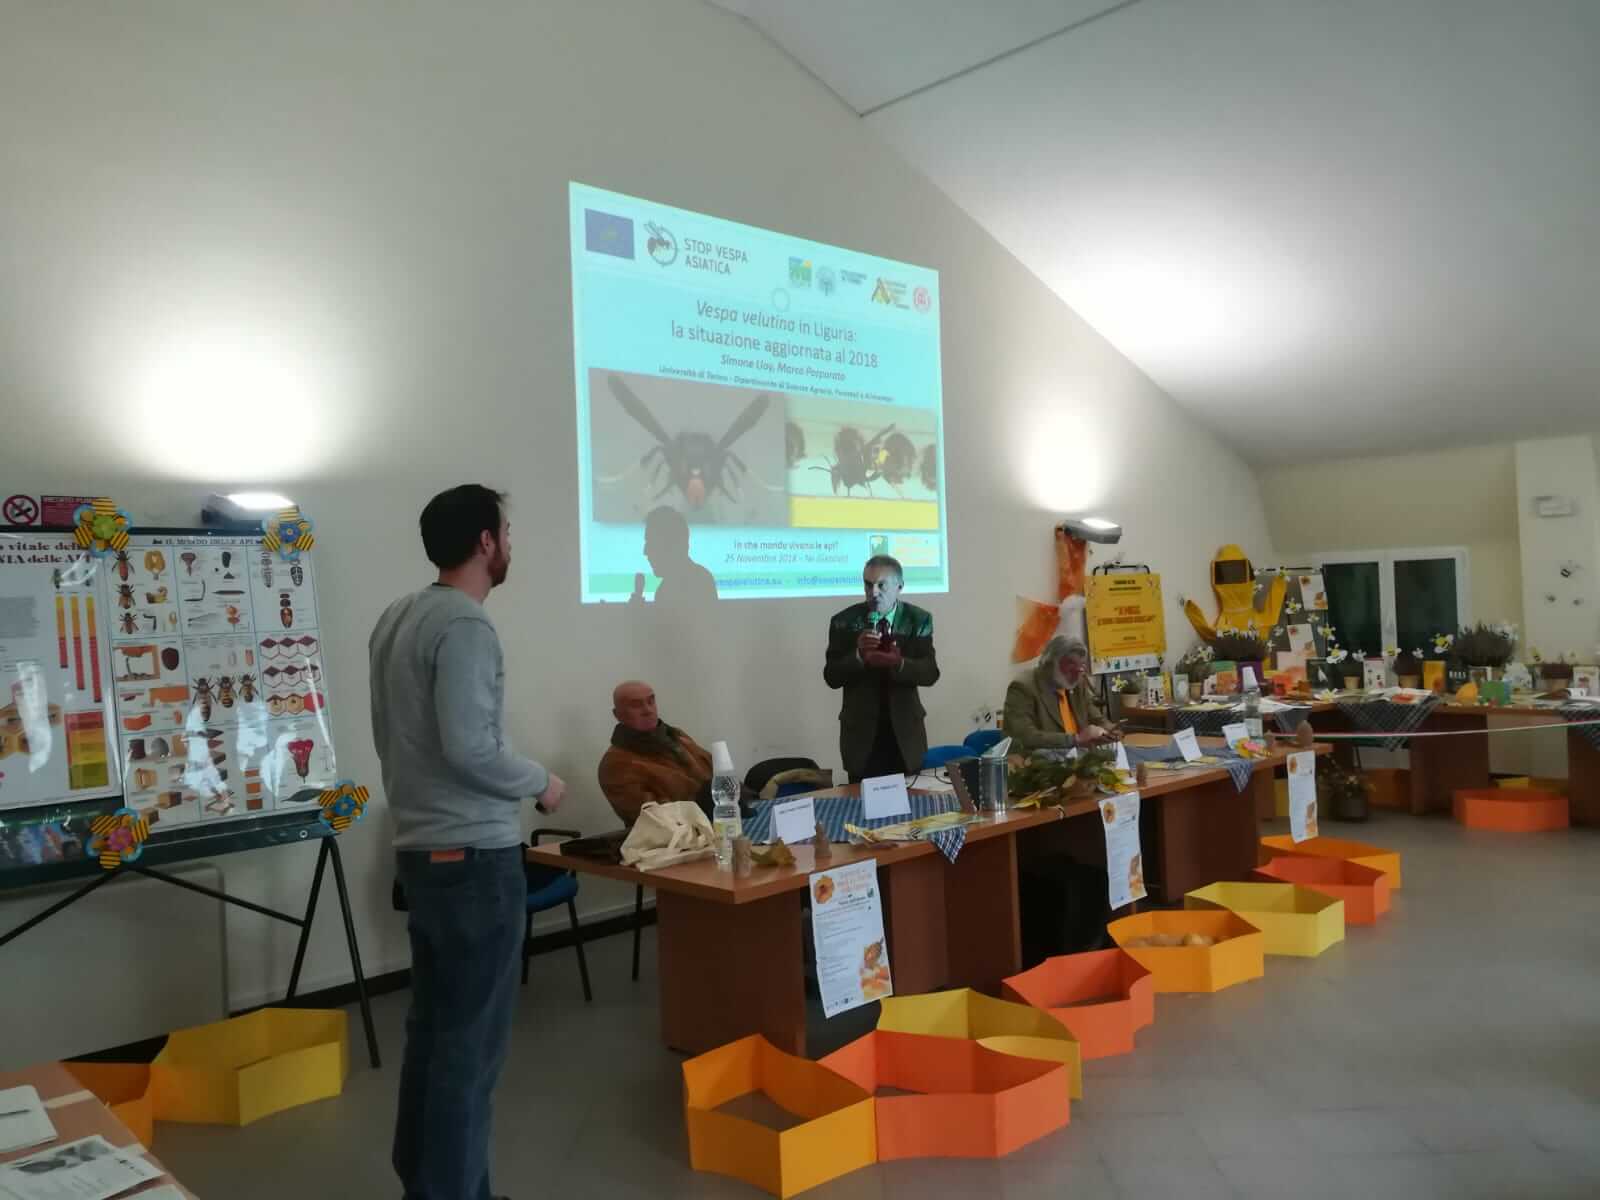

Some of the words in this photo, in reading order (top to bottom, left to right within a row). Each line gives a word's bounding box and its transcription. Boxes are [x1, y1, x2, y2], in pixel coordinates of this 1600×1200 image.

[684, 238, 712, 255] STOP
[716, 244, 748, 264] VESPA
[685, 255, 732, 275] ASIATICA
[697, 300, 738, 323] Vespa
[799, 318, 811, 334] in
[814, 320, 858, 343] Liguria:
[671, 320, 684, 338] la
[688, 323, 761, 351] situazione
[764, 338, 832, 361] aggiornata
[835, 348, 846, 364] al
[849, 350, 879, 369] 2018
[720, 354, 754, 369] Simone
[8, 541, 50, 551] vitale
